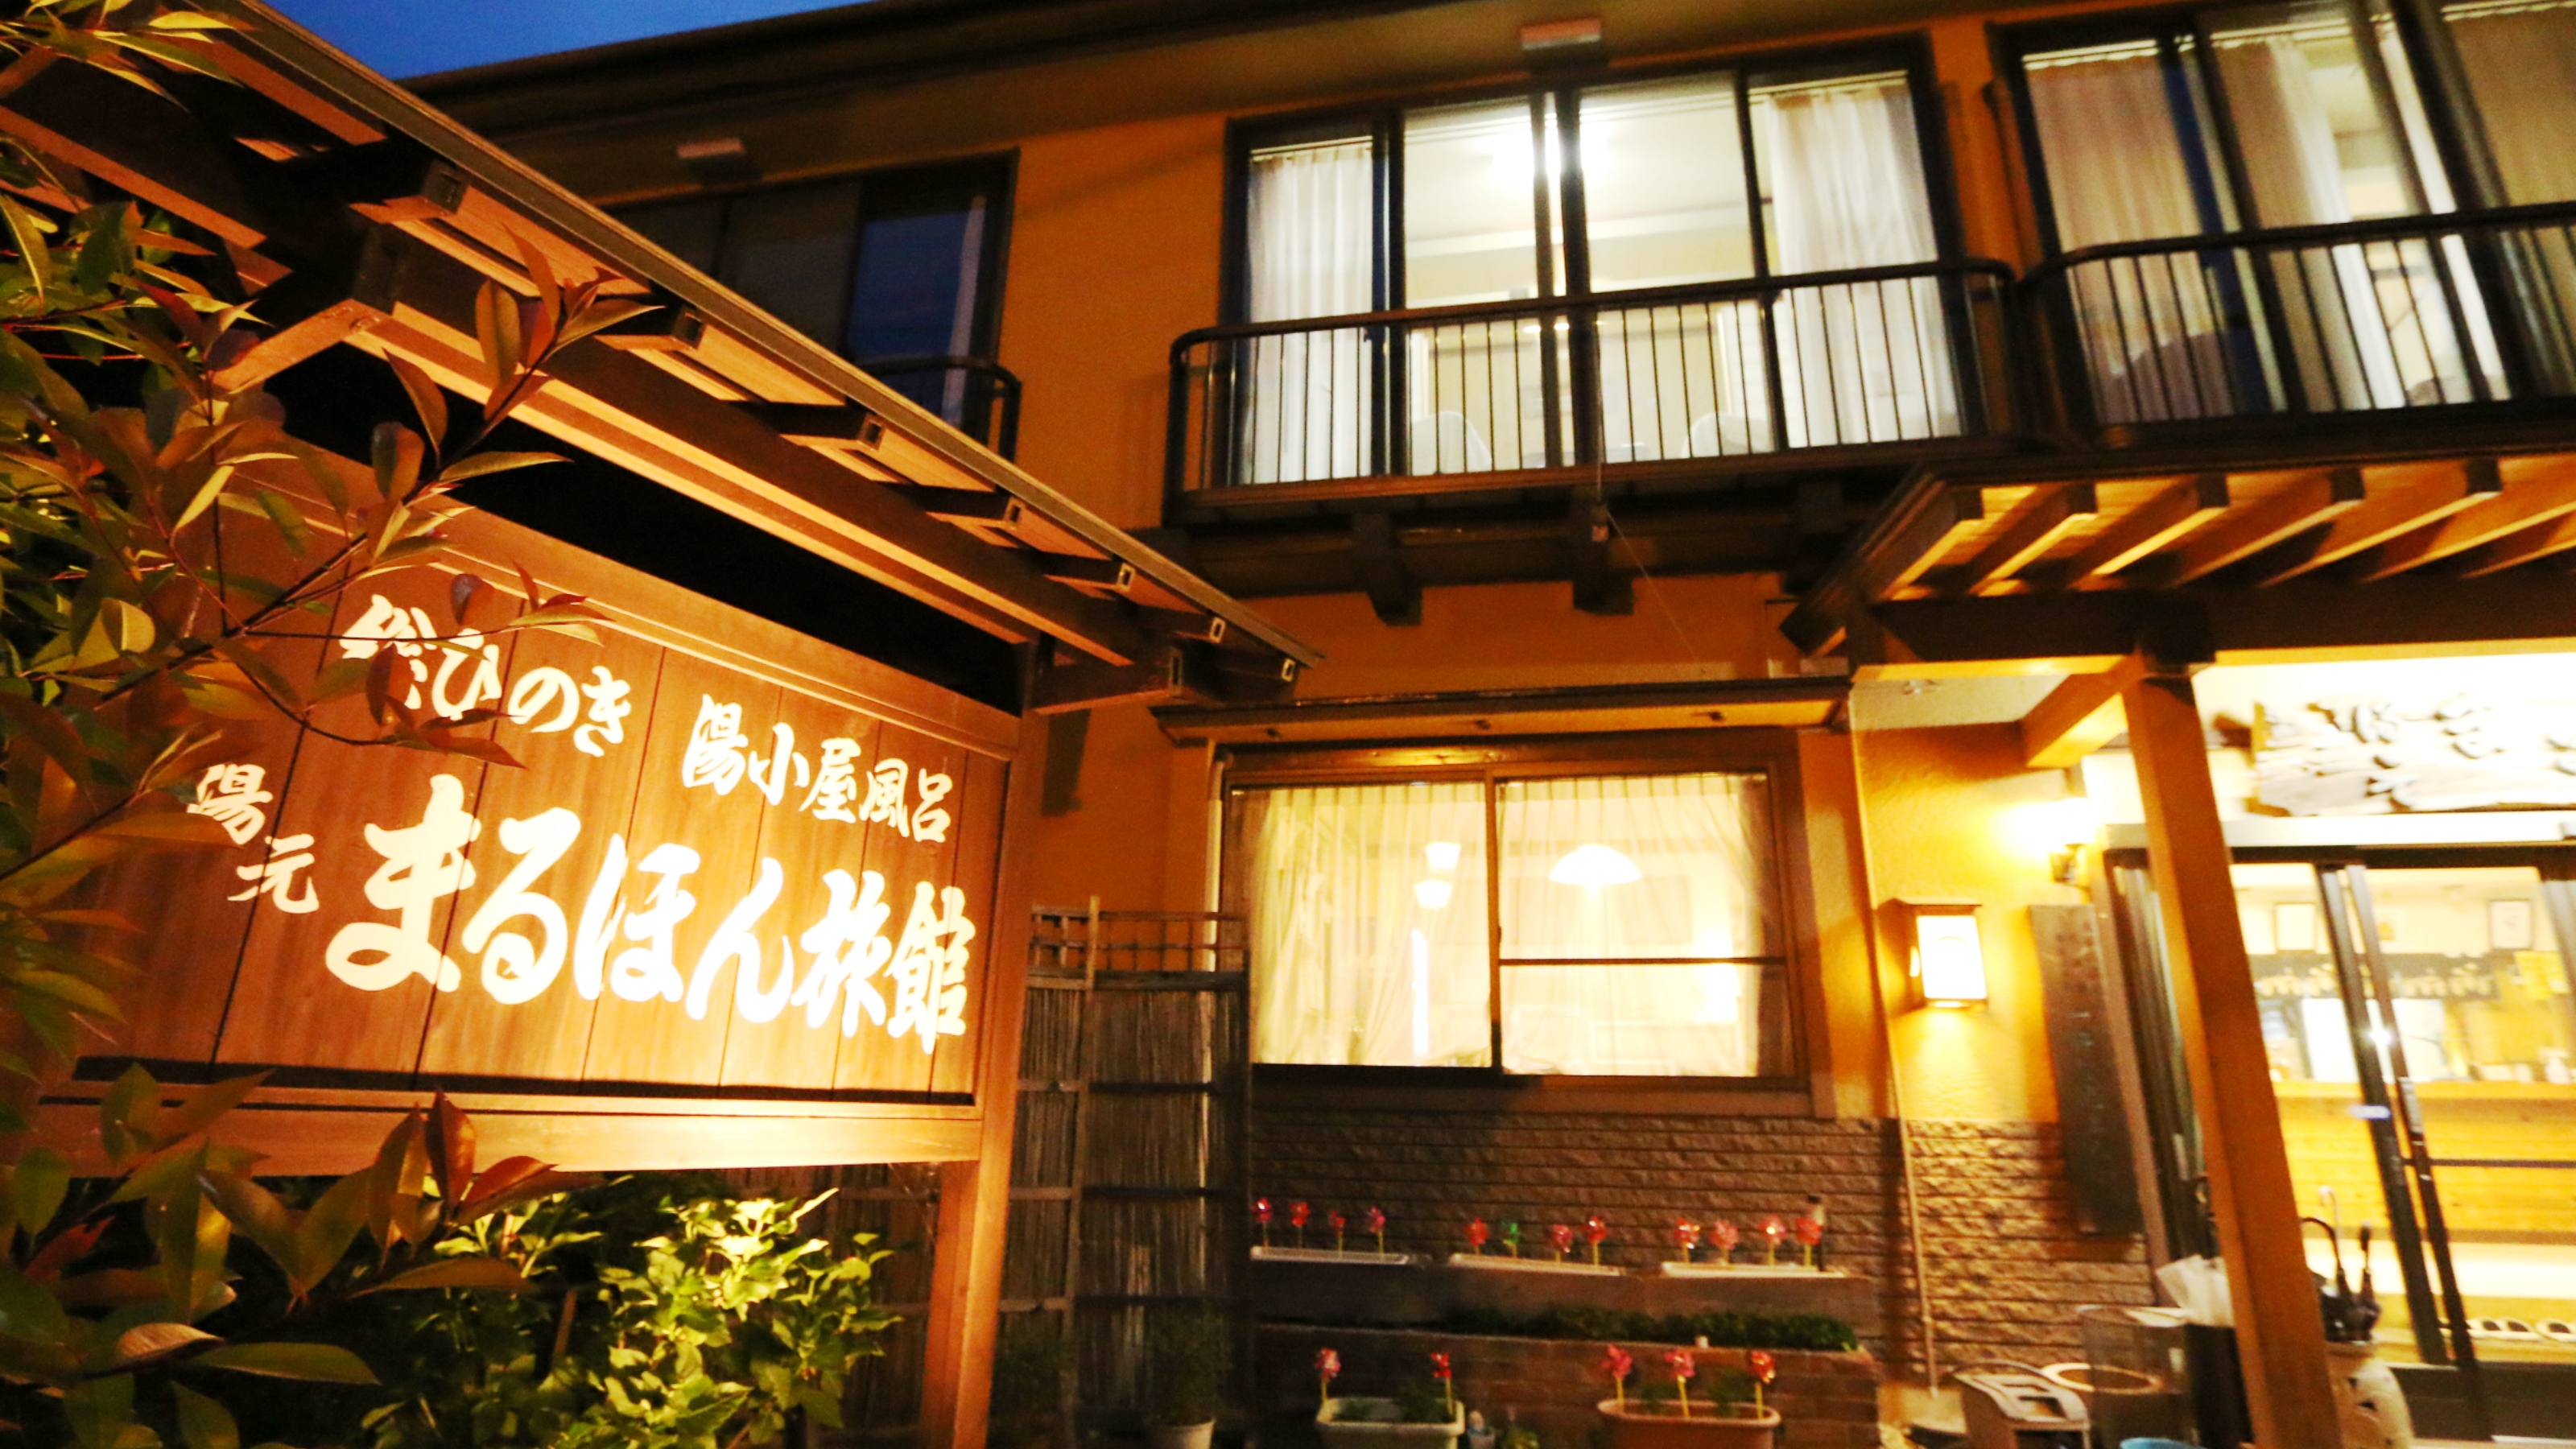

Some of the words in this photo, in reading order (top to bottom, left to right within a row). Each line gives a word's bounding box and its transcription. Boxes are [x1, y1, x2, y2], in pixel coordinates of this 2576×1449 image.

[681, 693, 952, 844] 湯小屋風呂
[325, 773, 976, 1055] まるほん旅館
